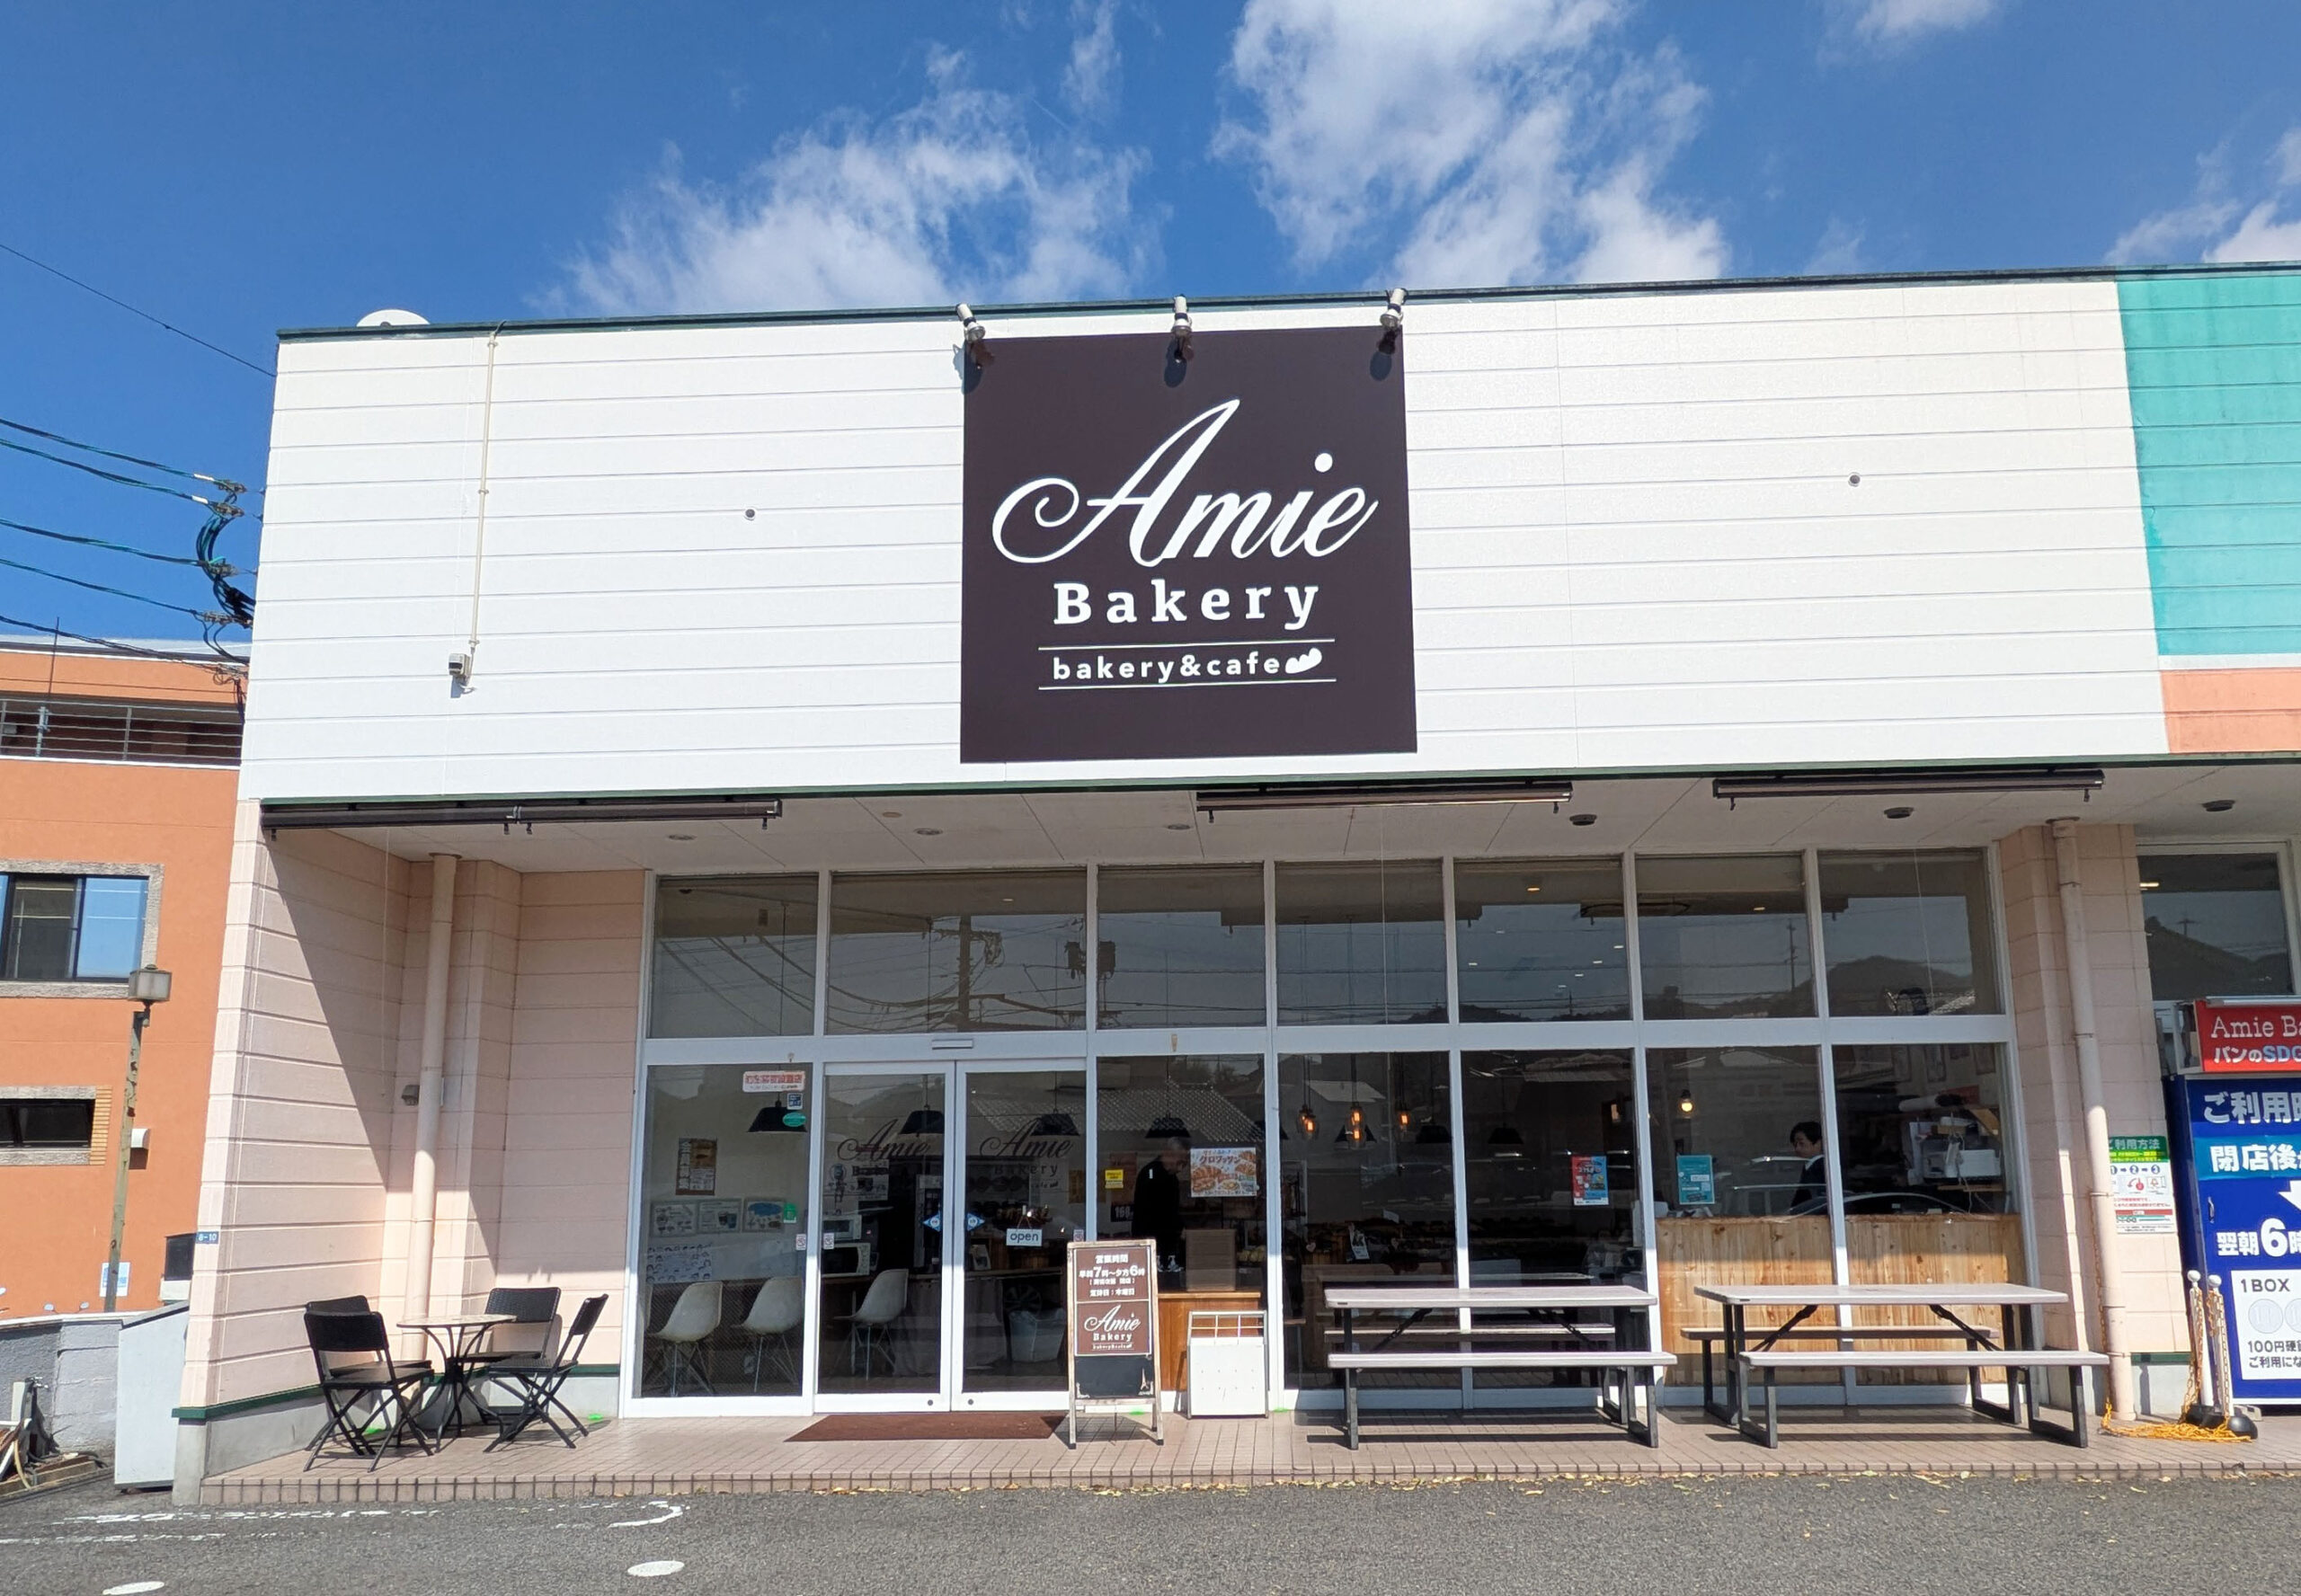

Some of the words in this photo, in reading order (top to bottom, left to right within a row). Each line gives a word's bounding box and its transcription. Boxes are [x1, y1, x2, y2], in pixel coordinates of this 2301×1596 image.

[991, 398, 1379, 567] Amie
[1053, 579, 1319, 630] Bakery
[1053, 652, 1281, 683] bakery&cafe
[2210, 1015, 2274, 1038] Amie
[2281, 1015, 2301, 1037] B
[837, 1119, 931, 1161] Amie
[2210, 1143, 2301, 1172] 閉店後
[1010, 1233, 1039, 1244] open
[1084, 1305, 1141, 1332] Amie
[1092, 1332, 1133, 1342] Bakery
